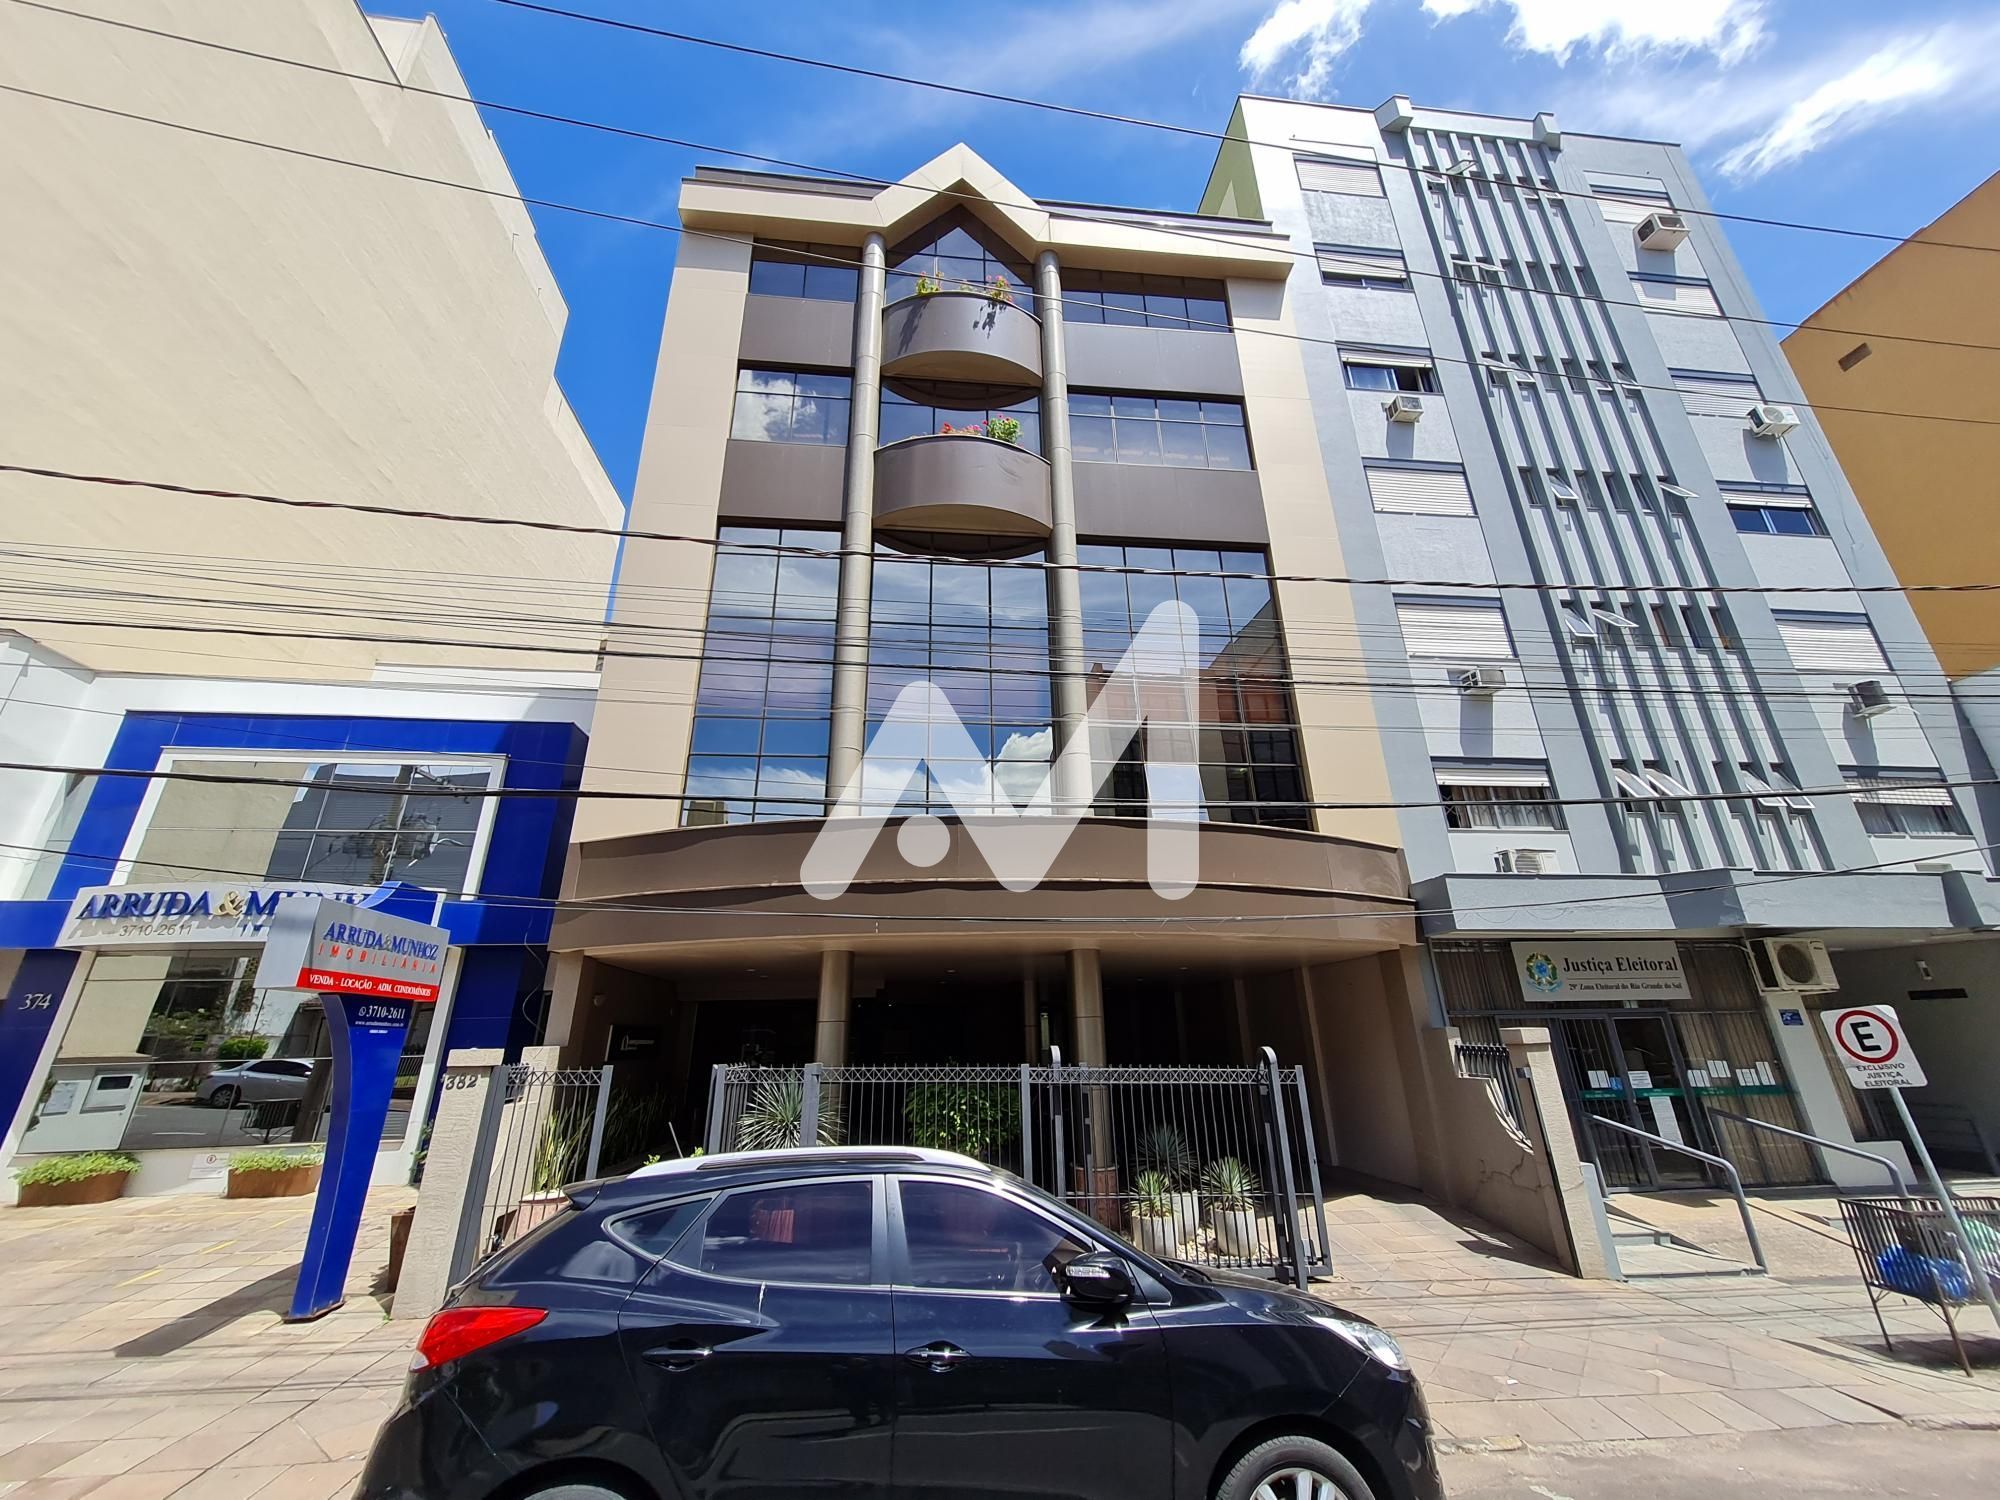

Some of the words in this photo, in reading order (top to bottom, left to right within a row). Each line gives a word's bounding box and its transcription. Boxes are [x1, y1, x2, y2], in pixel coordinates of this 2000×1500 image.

[120, 923, 193, 937] 3710-2611
[1563, 957, 1613, 975] Justiça
[1615, 956, 1679, 972] Eleitoral
[309, 973, 334, 985] VENDA
[340, 976, 373, 990] LOCAÇÃO
[18, 993, 52, 1010] 374
[366, 1004, 406, 1019] 3710-2611
[1849, 1021, 1882, 1052] E
[1856, 1062, 1906, 1072] EXCLUSIVO
[445, 1072, 479, 1091] 382
[1864, 1079, 1913, 1088] ELEITORAL
[1866, 1071, 1904, 1080] JUSTIÇA
